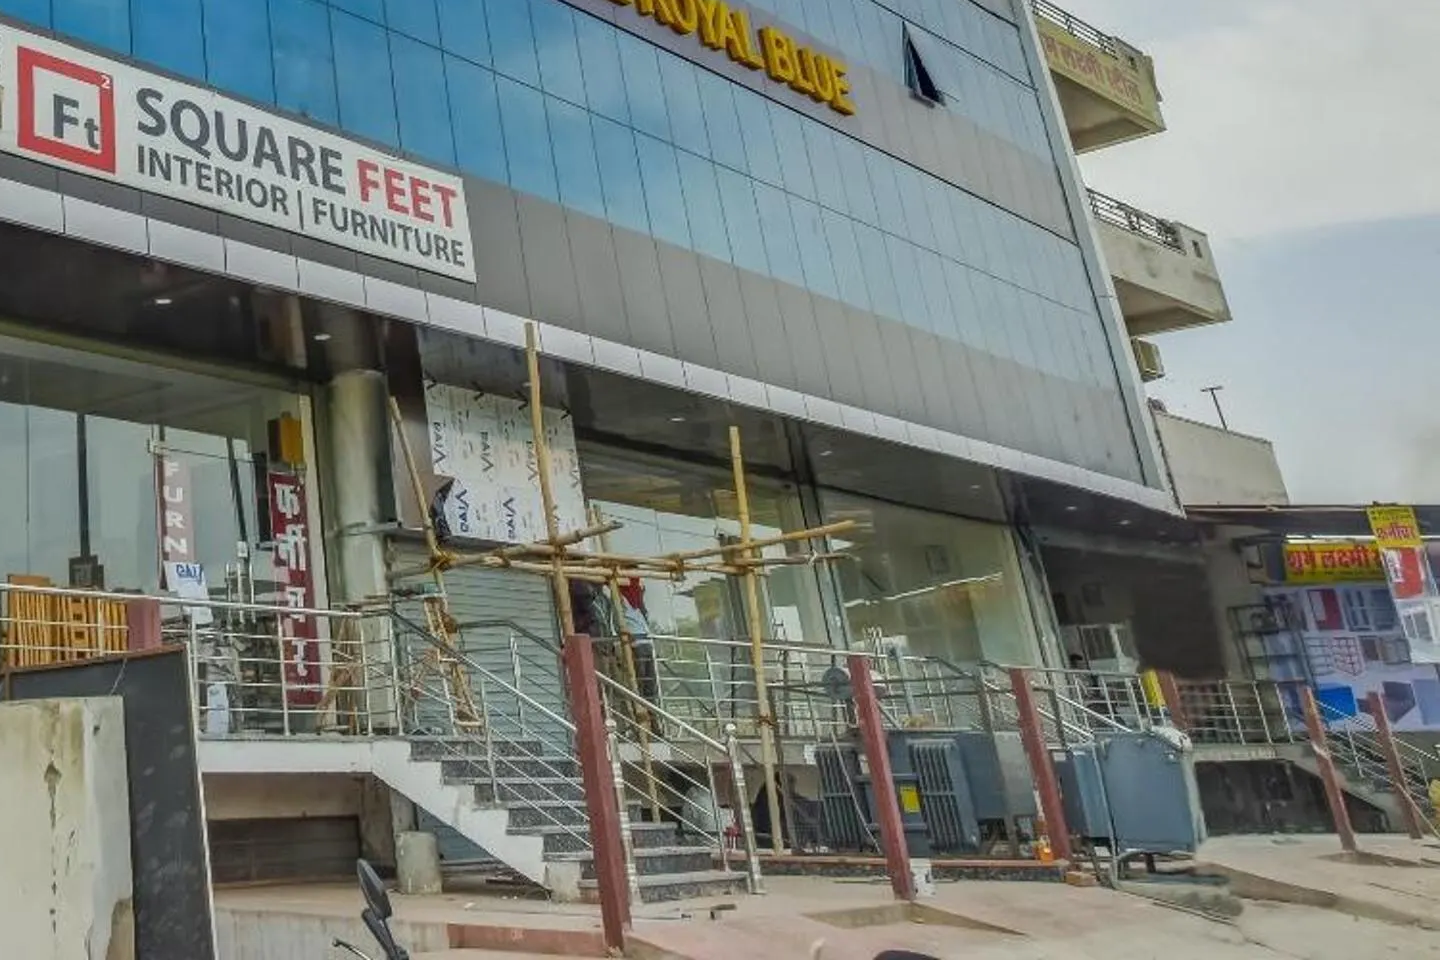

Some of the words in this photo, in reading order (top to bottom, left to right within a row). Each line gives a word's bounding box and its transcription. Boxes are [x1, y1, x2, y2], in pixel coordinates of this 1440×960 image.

[53, 93, 99, 150] Ft
[758, 25, 856, 116] BLUE
[136, 88, 347, 195] SQUARE
[356, 159, 458, 228] FEET
[137, 144, 290, 216] INTERIOR
[312, 196, 466, 268] FURNITURE
